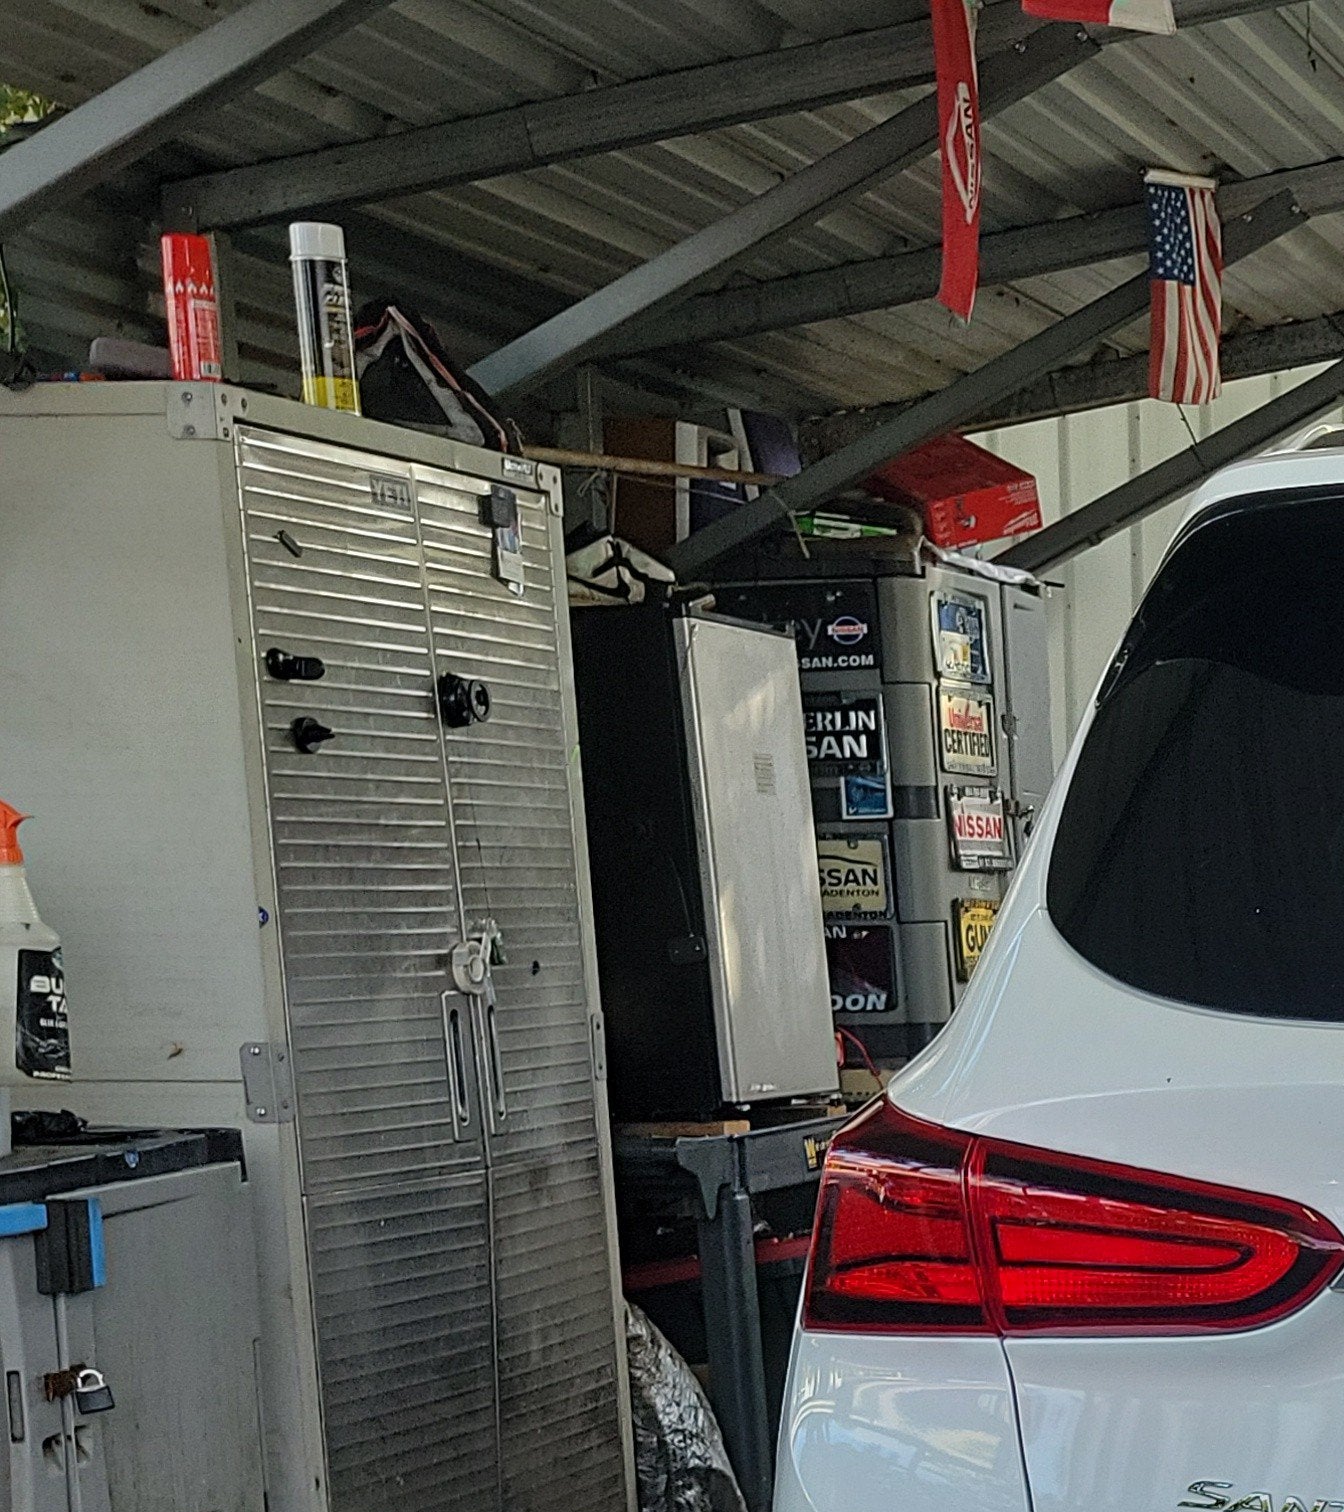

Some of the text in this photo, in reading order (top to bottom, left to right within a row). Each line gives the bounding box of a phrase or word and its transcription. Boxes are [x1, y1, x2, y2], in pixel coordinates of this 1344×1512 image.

[801, 654, 874, 669] SAN.COM
[803, 709, 875, 731] ERLIN
[806, 733, 868, 759] SAN
[944, 728, 990, 757] CERTIFIED
[955, 814, 1002, 839] NISSAN
[822, 888, 880, 898] ADENTON
